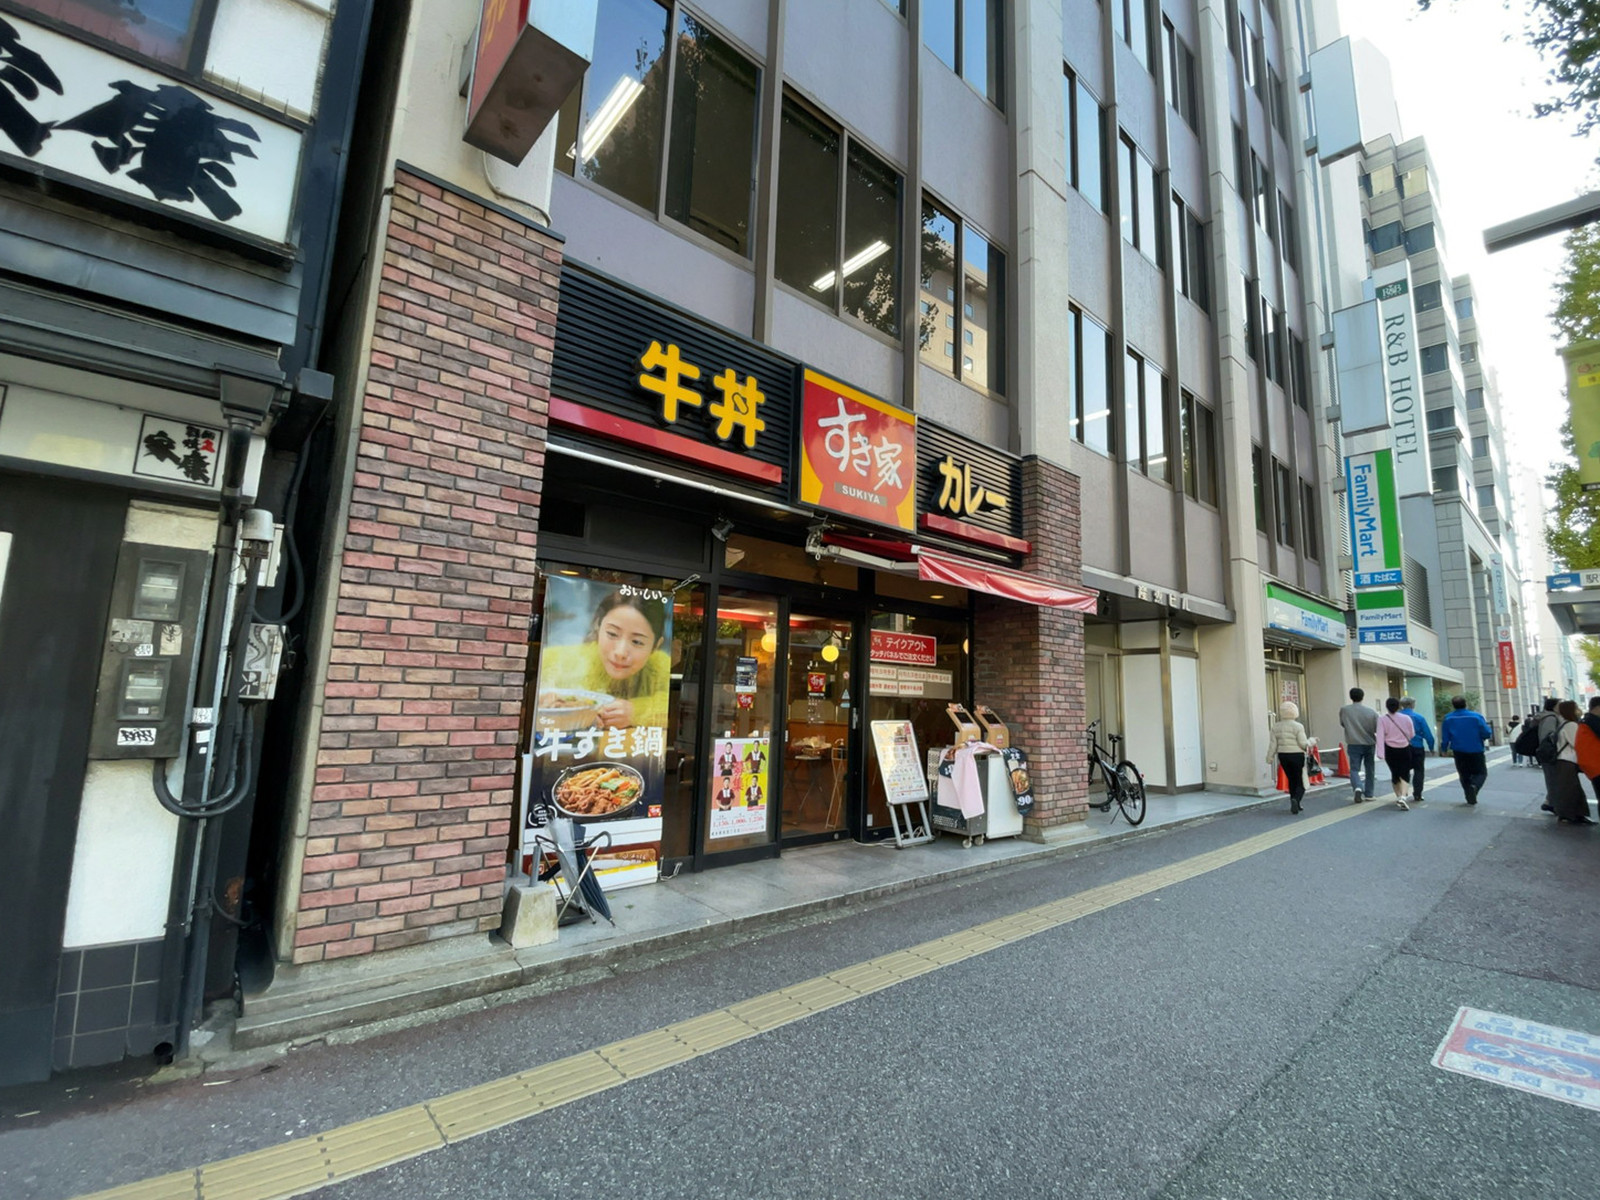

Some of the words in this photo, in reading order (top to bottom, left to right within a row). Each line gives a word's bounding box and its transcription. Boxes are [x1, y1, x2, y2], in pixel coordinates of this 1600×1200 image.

[1385, 313, 1409, 367] R&B
[640, 341, 766, 448] 牛丼
[1391, 376, 1418, 464] HOTEL
[818, 397, 903, 491] すき家
[842, 485, 881, 505] SUKIYA
[939, 456, 1007, 516] カレー
[1354, 463, 1377, 557] FamilyMart
[1360, 573, 1371, 584] 酒
[1374, 572, 1397, 582] たばこ
[619, 584, 669, 604] おいしい。
[1301, 610, 1329, 633] FamilyMart
[1360, 612, 1402, 622] FamilyMart
[886, 637, 927, 651] テイクアウト
[1364, 631, 1376, 641] 酒
[1379, 632, 1402, 641] たばこ
[870, 649, 935, 663] タッチパネルでご注文ください
[535, 726, 663, 762] 牛すき鍋
